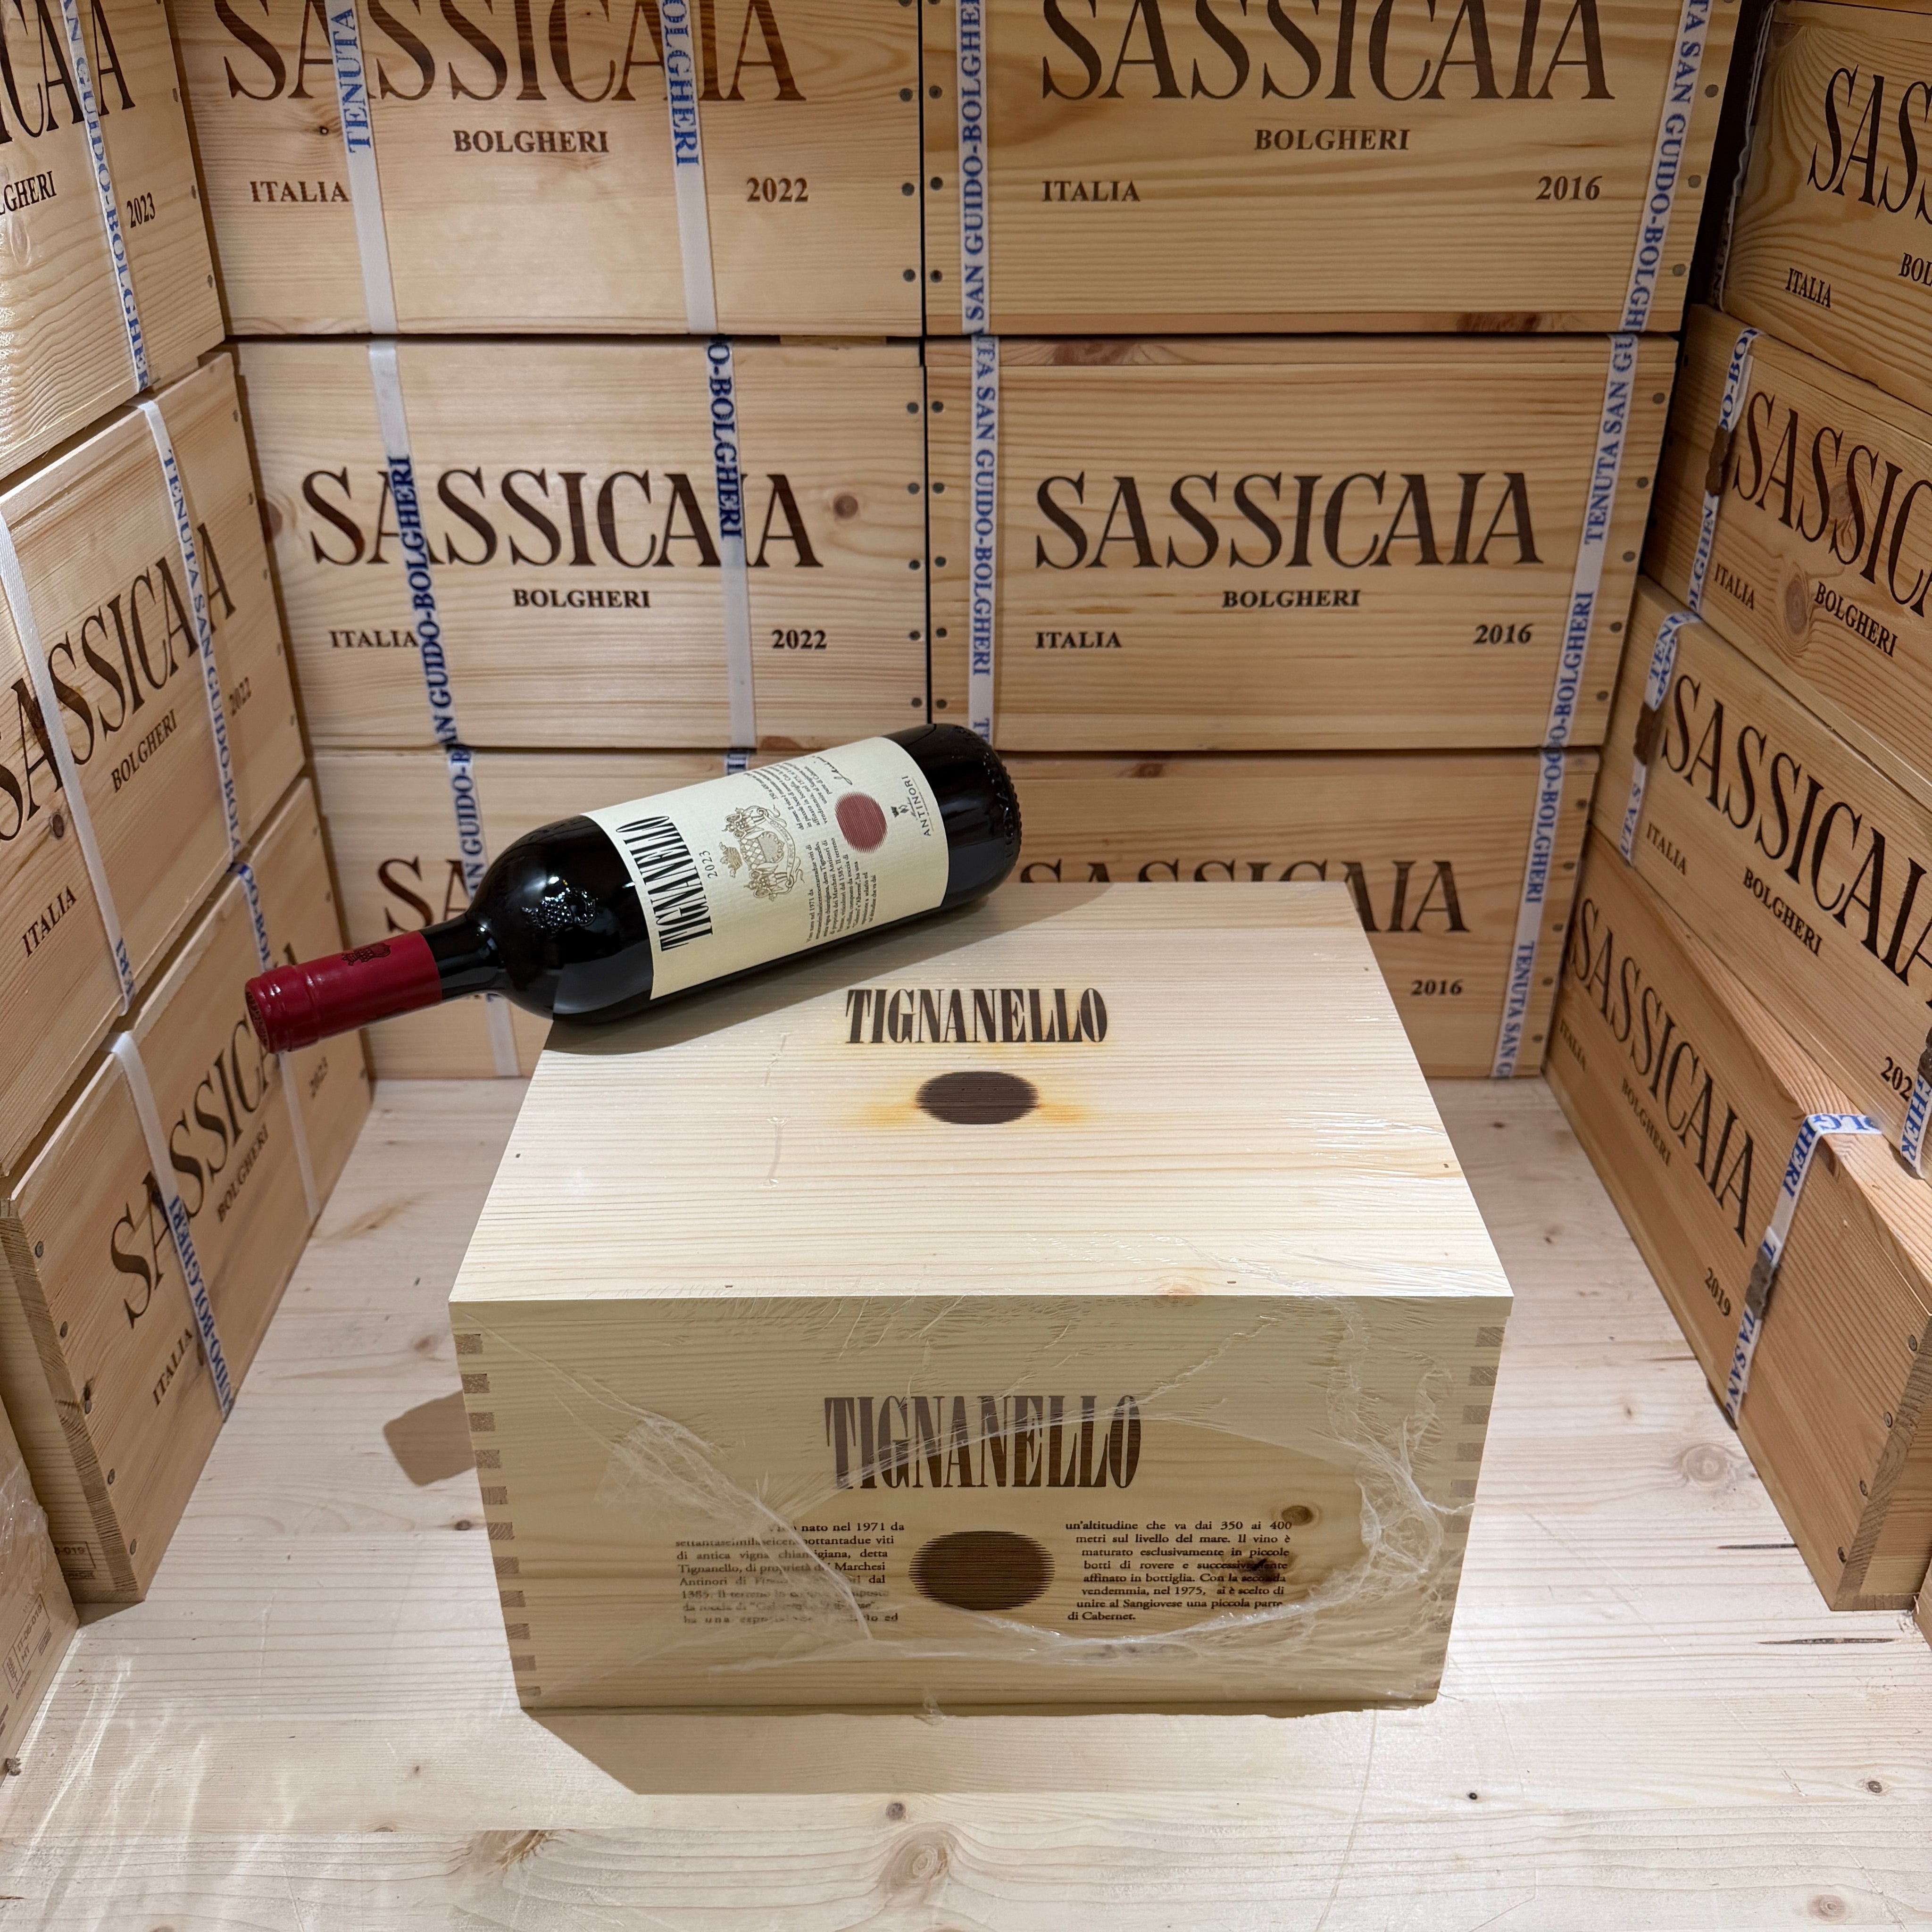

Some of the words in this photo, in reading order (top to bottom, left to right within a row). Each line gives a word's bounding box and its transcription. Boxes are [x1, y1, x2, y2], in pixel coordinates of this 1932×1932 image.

[1042, 0, 1615, 100] SASSICAIA
[330, 8, 371, 153] TENUTA
[1672, 41, 1701, 105] SAN
[454, 130, 610, 153] BOLGHERI
[1254, 128, 1410, 151] BOLGHERI
[250, 181, 349, 203] ITALIA
[746, 177, 808, 203] 2022
[1041, 181, 1141, 202] ITALIA
[1536, 175, 1602, 201] 2016
[127, 192, 156, 229] 2023
[964, 263, 984, 321] SAN
[1785, 267, 1831, 309] ITALIA
[976, 386, 996, 441] SAN
[1584, 441, 1619, 545] TENUTA
[1602, 381, 1629, 435] SAN
[1036, 471, 1544, 569] SASSICAIA
[1734, 391, 1932, 617] SASSIC
[164, 449, 200, 590] TENUTA
[192, 593, 214, 660] SAN
[973, 449, 995, 676] GUIDO-BOLGHERI
[387, 454, 452, 709] GUIDO-BOLGHERI
[513, 590, 650, 608] BOLGHERI
[1222, 590, 1360, 608] BOLGHERI
[1713, 563, 1756, 610] ITALIA
[329, 630, 418, 649] ITALIA
[772, 629, 827, 650] 2022
[1036, 631, 1123, 649] ITALIA
[1473, 622, 1535, 645] 2016
[1814, 580, 1898, 658] BOLGHERI
[110, 708, 178, 793] BOLGHERI
[901, 775, 931, 837] ANTINORI
[699, 850, 718, 879] 2023
[824, 848, 835, 872] Antinori
[1646, 822, 1687, 876] ITALIA
[615, 816, 713, 952] TIGNANELLO
[21, 886, 77, 958] ITALIA
[1742, 867, 1823, 957] BOLGHERI
[1411, 978, 1464, 997] 2016
[1506, 940, 1535, 1019] TENUTA
[845, 987, 1108, 1044] TIGNANELLO
[1499, 1020, 1522, 1067] SAN
[1558, 1018, 1587, 1072] ITALIA
[1570, 898, 1754, 1247] SASSICAIA
[1880, 1056, 1913, 1102] 202
[1621, 1077, 1671, 1167] BOLGHERI
[217, 1124, 269, 1223] BOLGHERI
[1704, 1266, 1732, 1317] 2019
[151, 1328, 192, 1407] ITALIA
[824, 1395, 1141, 1489] TIGNANELLO
[833, 1522, 850, 1531] nel
[857, 1523, 885, 1531] 1971
[891, 1522, 904, 1531] da
[876, 1535, 894, 1544] viti
[1066, 1521, 1138, 1530] un'altitudine
[1146, 1521, 1166, 1530] che
[1195, 1521, 1212, 1530] dai
[1220, 1521, 1243, 1530] 350
[1251, 1521, 1261, 1530] ai
[1270, 1521, 1292, 1530] 400
[1076, 1534, 1107, 1543] metri
[1112, 1534, 1128, 1543] sul
[1135, 1534, 1169, 1543] livello
[1175, 1534, 1193, 1543] del
[1237, 1534, 1247, 1543] Il
[1253, 1534, 1278, 1543] vino
[1284, 1534, 1291, 1543] è
[677, 1551, 687, 1559] di
[697, 1551, 730, 1559] antica
[740, 1551, 770, 1561] vigna
[860, 1549, 888, 1557] detta
[678, 1564, 742, 1575] Tignanello,
[746, 1564, 756, 1572] di
[834, 1562, 885, 1571] Marchesi
[1084, 1561, 1111, 1569] botti
[1120, 1561, 1131, 1569] di
[1140, 1548, 1224, 1556] esclusivamente
[1230, 1548, 1242, 1556] in
[1249, 1548, 1290, 1559] piccole
[680, 1578, 727, 1586] Antinori
[868, 1575, 885, 1583] dal
[1082, 1587, 1149, 1596] vendemmia,
[1153, 1587, 1170, 1595] nel
[1175, 1587, 1206, 1596] 1975,
[1217, 1587, 1225, 1595] si
[1229, 1587, 1235, 1595] è
[1239, 1587, 1270, 1595] scelto
[1274, 1587, 1284, 1595] di
[1083, 1574, 1127, 1582] affinato
[1131, 1574, 1141, 1582] in
[1146, 1574, 1196, 1584] bottiglia.
[1200, 1574, 1224, 1582] Con
[1228, 1574, 1238, 1582] la
[884, 1613, 898, 1621] ed
[1068, 1612, 1078, 1620] di
[1082, 1612, 1136, 1620] Cabernet.
[1123, 1600, 1183, 1609] Sangiovese
[1211, 1600, 1250, 1609] piccola
[1254, 1601, 1282, 1609] parte
